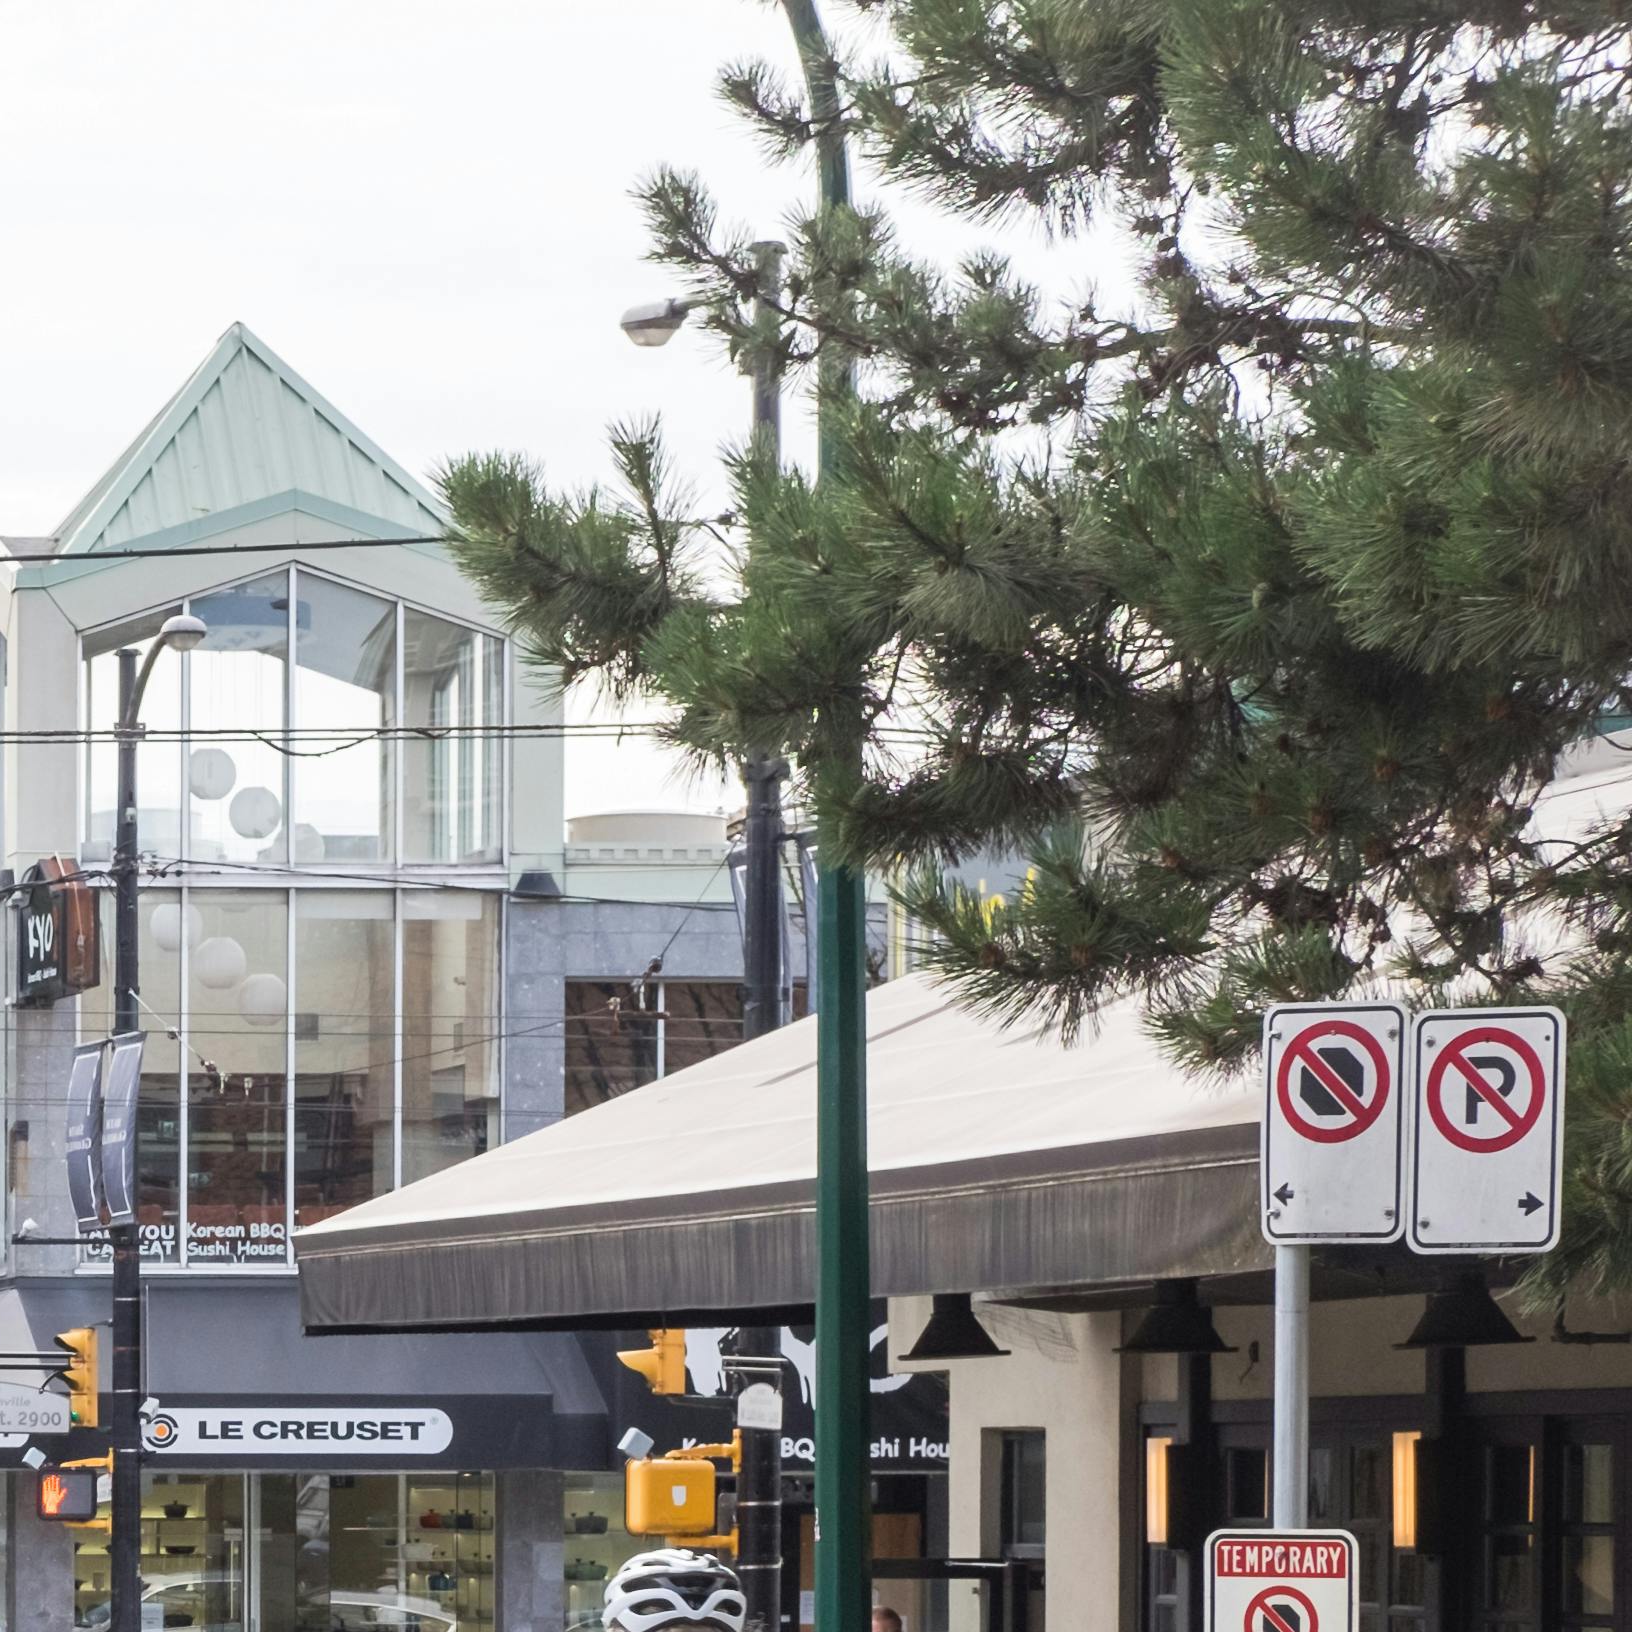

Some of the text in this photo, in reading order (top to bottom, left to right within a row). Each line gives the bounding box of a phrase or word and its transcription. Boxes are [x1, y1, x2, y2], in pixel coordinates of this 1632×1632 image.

[27, 913, 54, 961] KYO
[186, 1222, 285, 1239] Korean BBQ
[187, 1241, 286, 1256] Sushi House
[17, 1411, 62, 1427] 2900
[198, 1420, 426, 1441] LE CREUSET
[780, 1437, 950, 1462] BQ shi Hou
[1220, 1544, 1342, 1575] TEMPORARY
